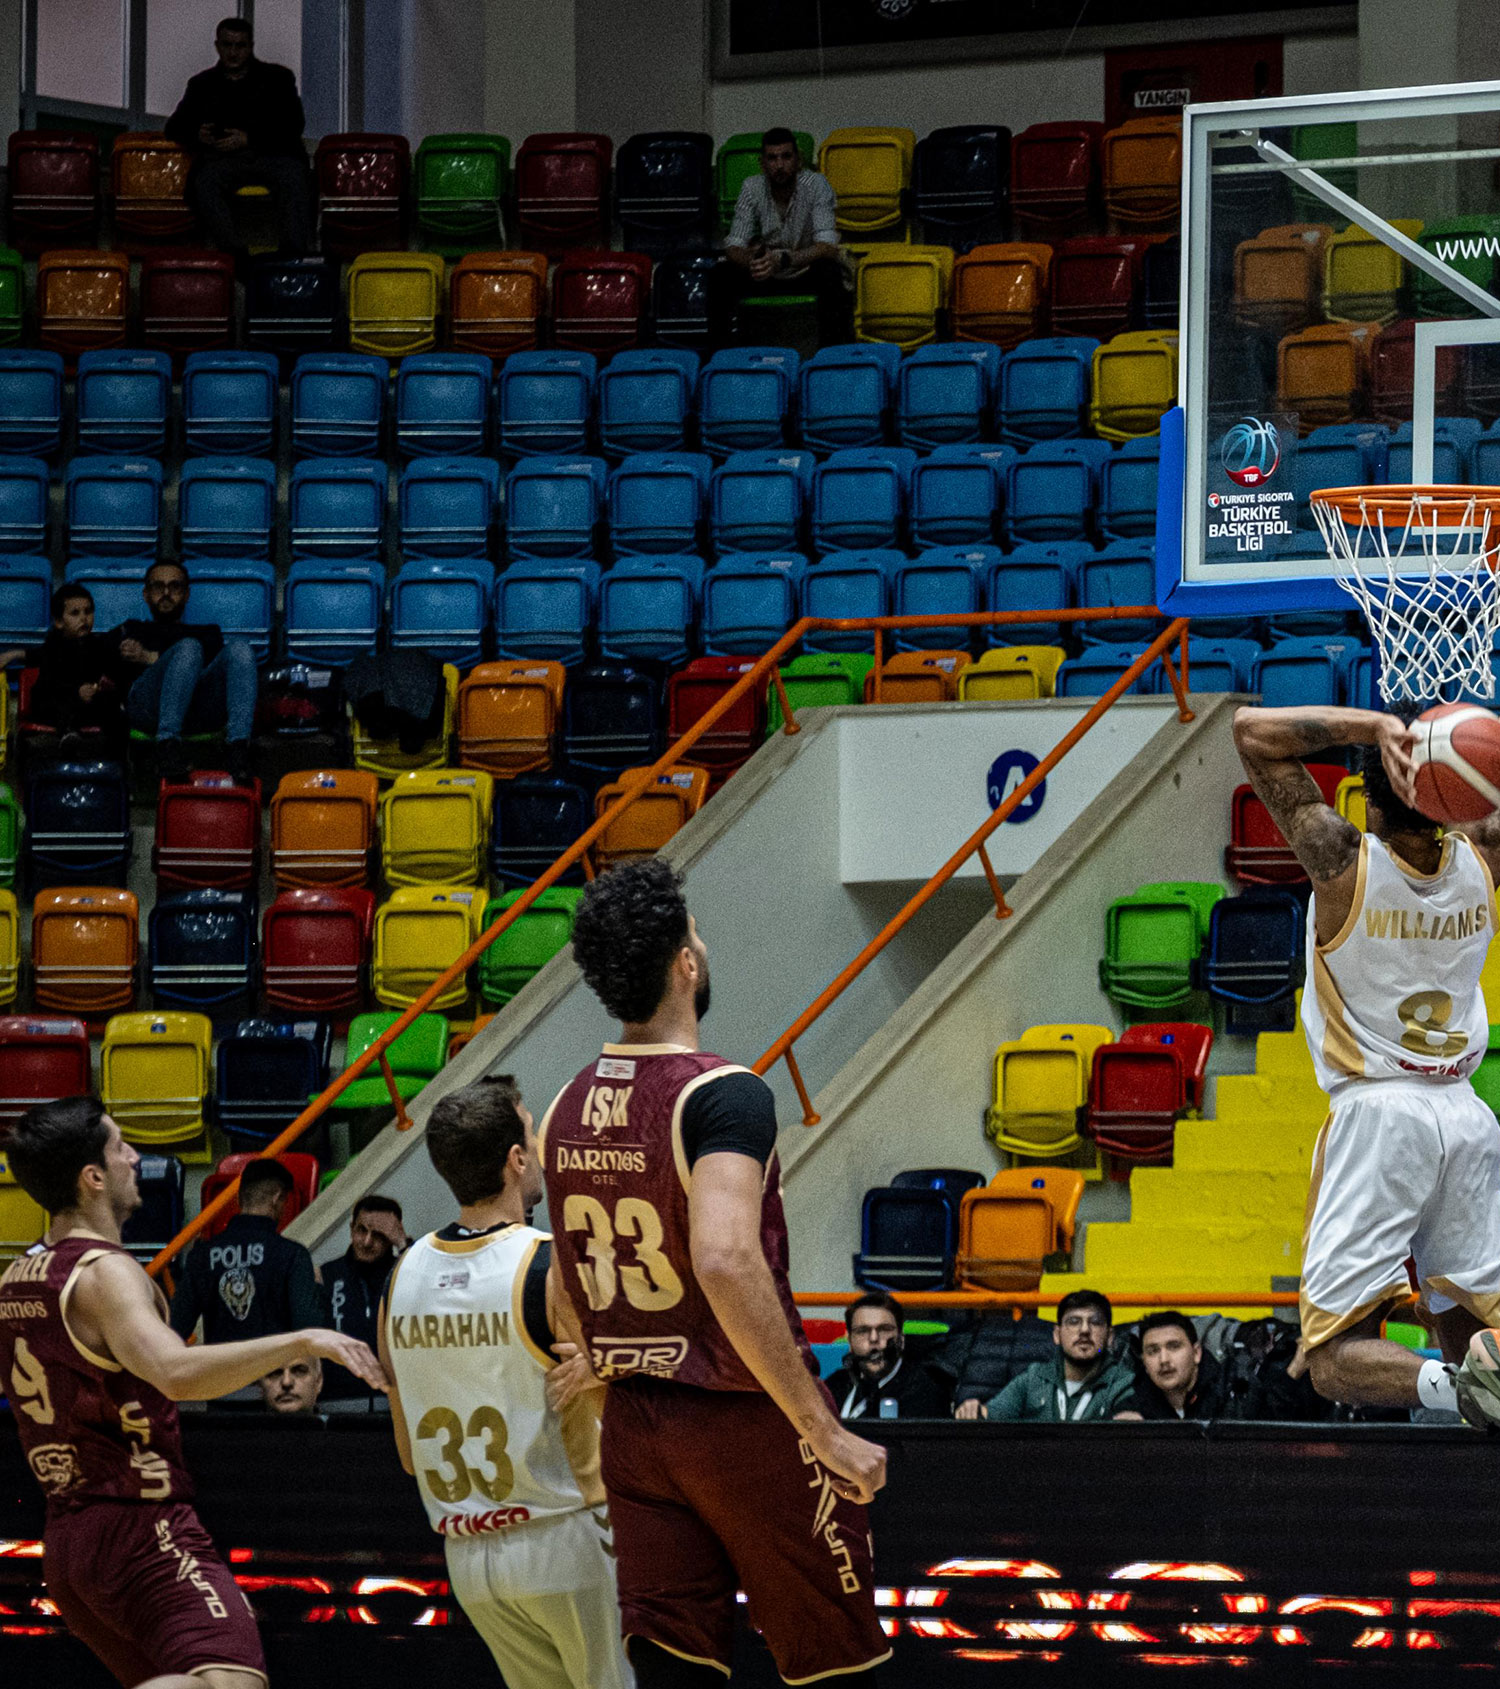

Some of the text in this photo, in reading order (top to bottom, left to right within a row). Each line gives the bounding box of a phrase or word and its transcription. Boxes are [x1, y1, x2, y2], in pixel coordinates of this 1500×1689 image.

[1208, 520, 1293, 538] BASKETBOL
[1221, 504, 1281, 522] TÜRKİYE
[1236, 534, 1264, 552] LİGİ
[1365, 904, 1488, 941] WILLIAMS
[1397, 990, 1469, 1058] 8
[209, 1243, 265, 1271] POLIS
[563, 1194, 685, 1312] 33
[391, 1311, 510, 1349] KARAHAN
[11, 1336, 55, 1425] 9
[416, 1405, 514, 1504] 33
